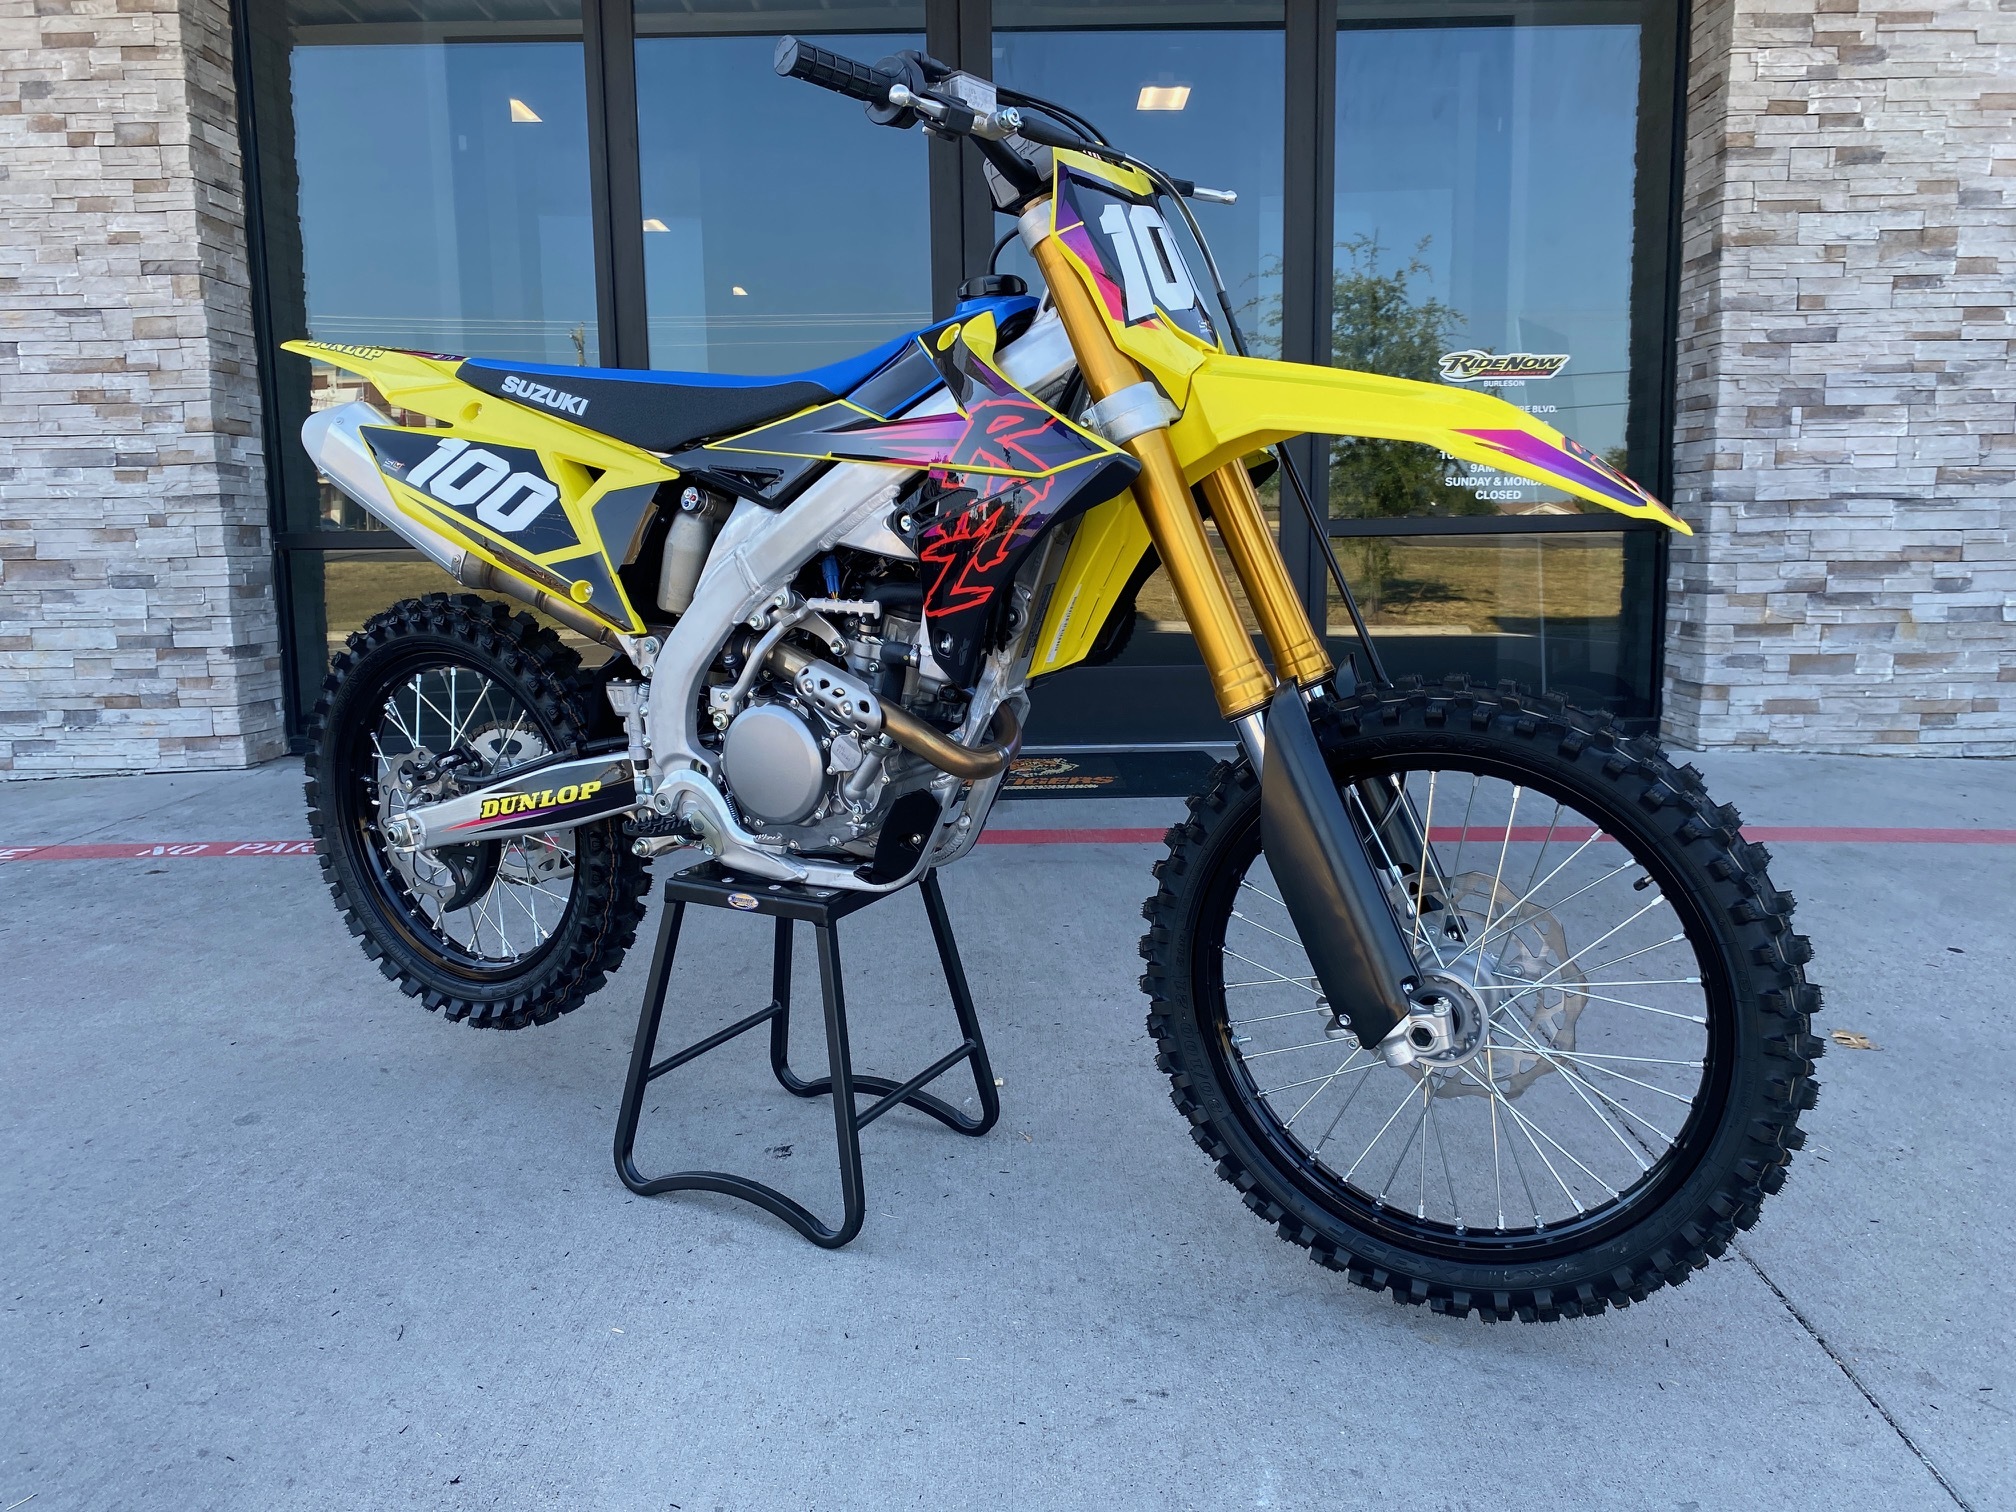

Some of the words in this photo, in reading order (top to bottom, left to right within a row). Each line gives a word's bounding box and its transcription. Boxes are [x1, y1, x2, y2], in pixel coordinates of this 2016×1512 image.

[1099, 204, 1212, 321] 10
[501, 376, 589, 416] SUZUKI
[1532, 404, 1558, 413] BLVD.
[1470, 464, 1495, 473] 9AM
[405, 437, 558, 533] 100
[1445, 477, 1491, 486] SUNDAY
[1493, 477, 1501, 486] &
[1475, 490, 1522, 500] CLOSED
[480, 780, 602, 819] DUNLOP
[136, 844, 209, 856] NO
[225, 842, 316, 854] PAR
